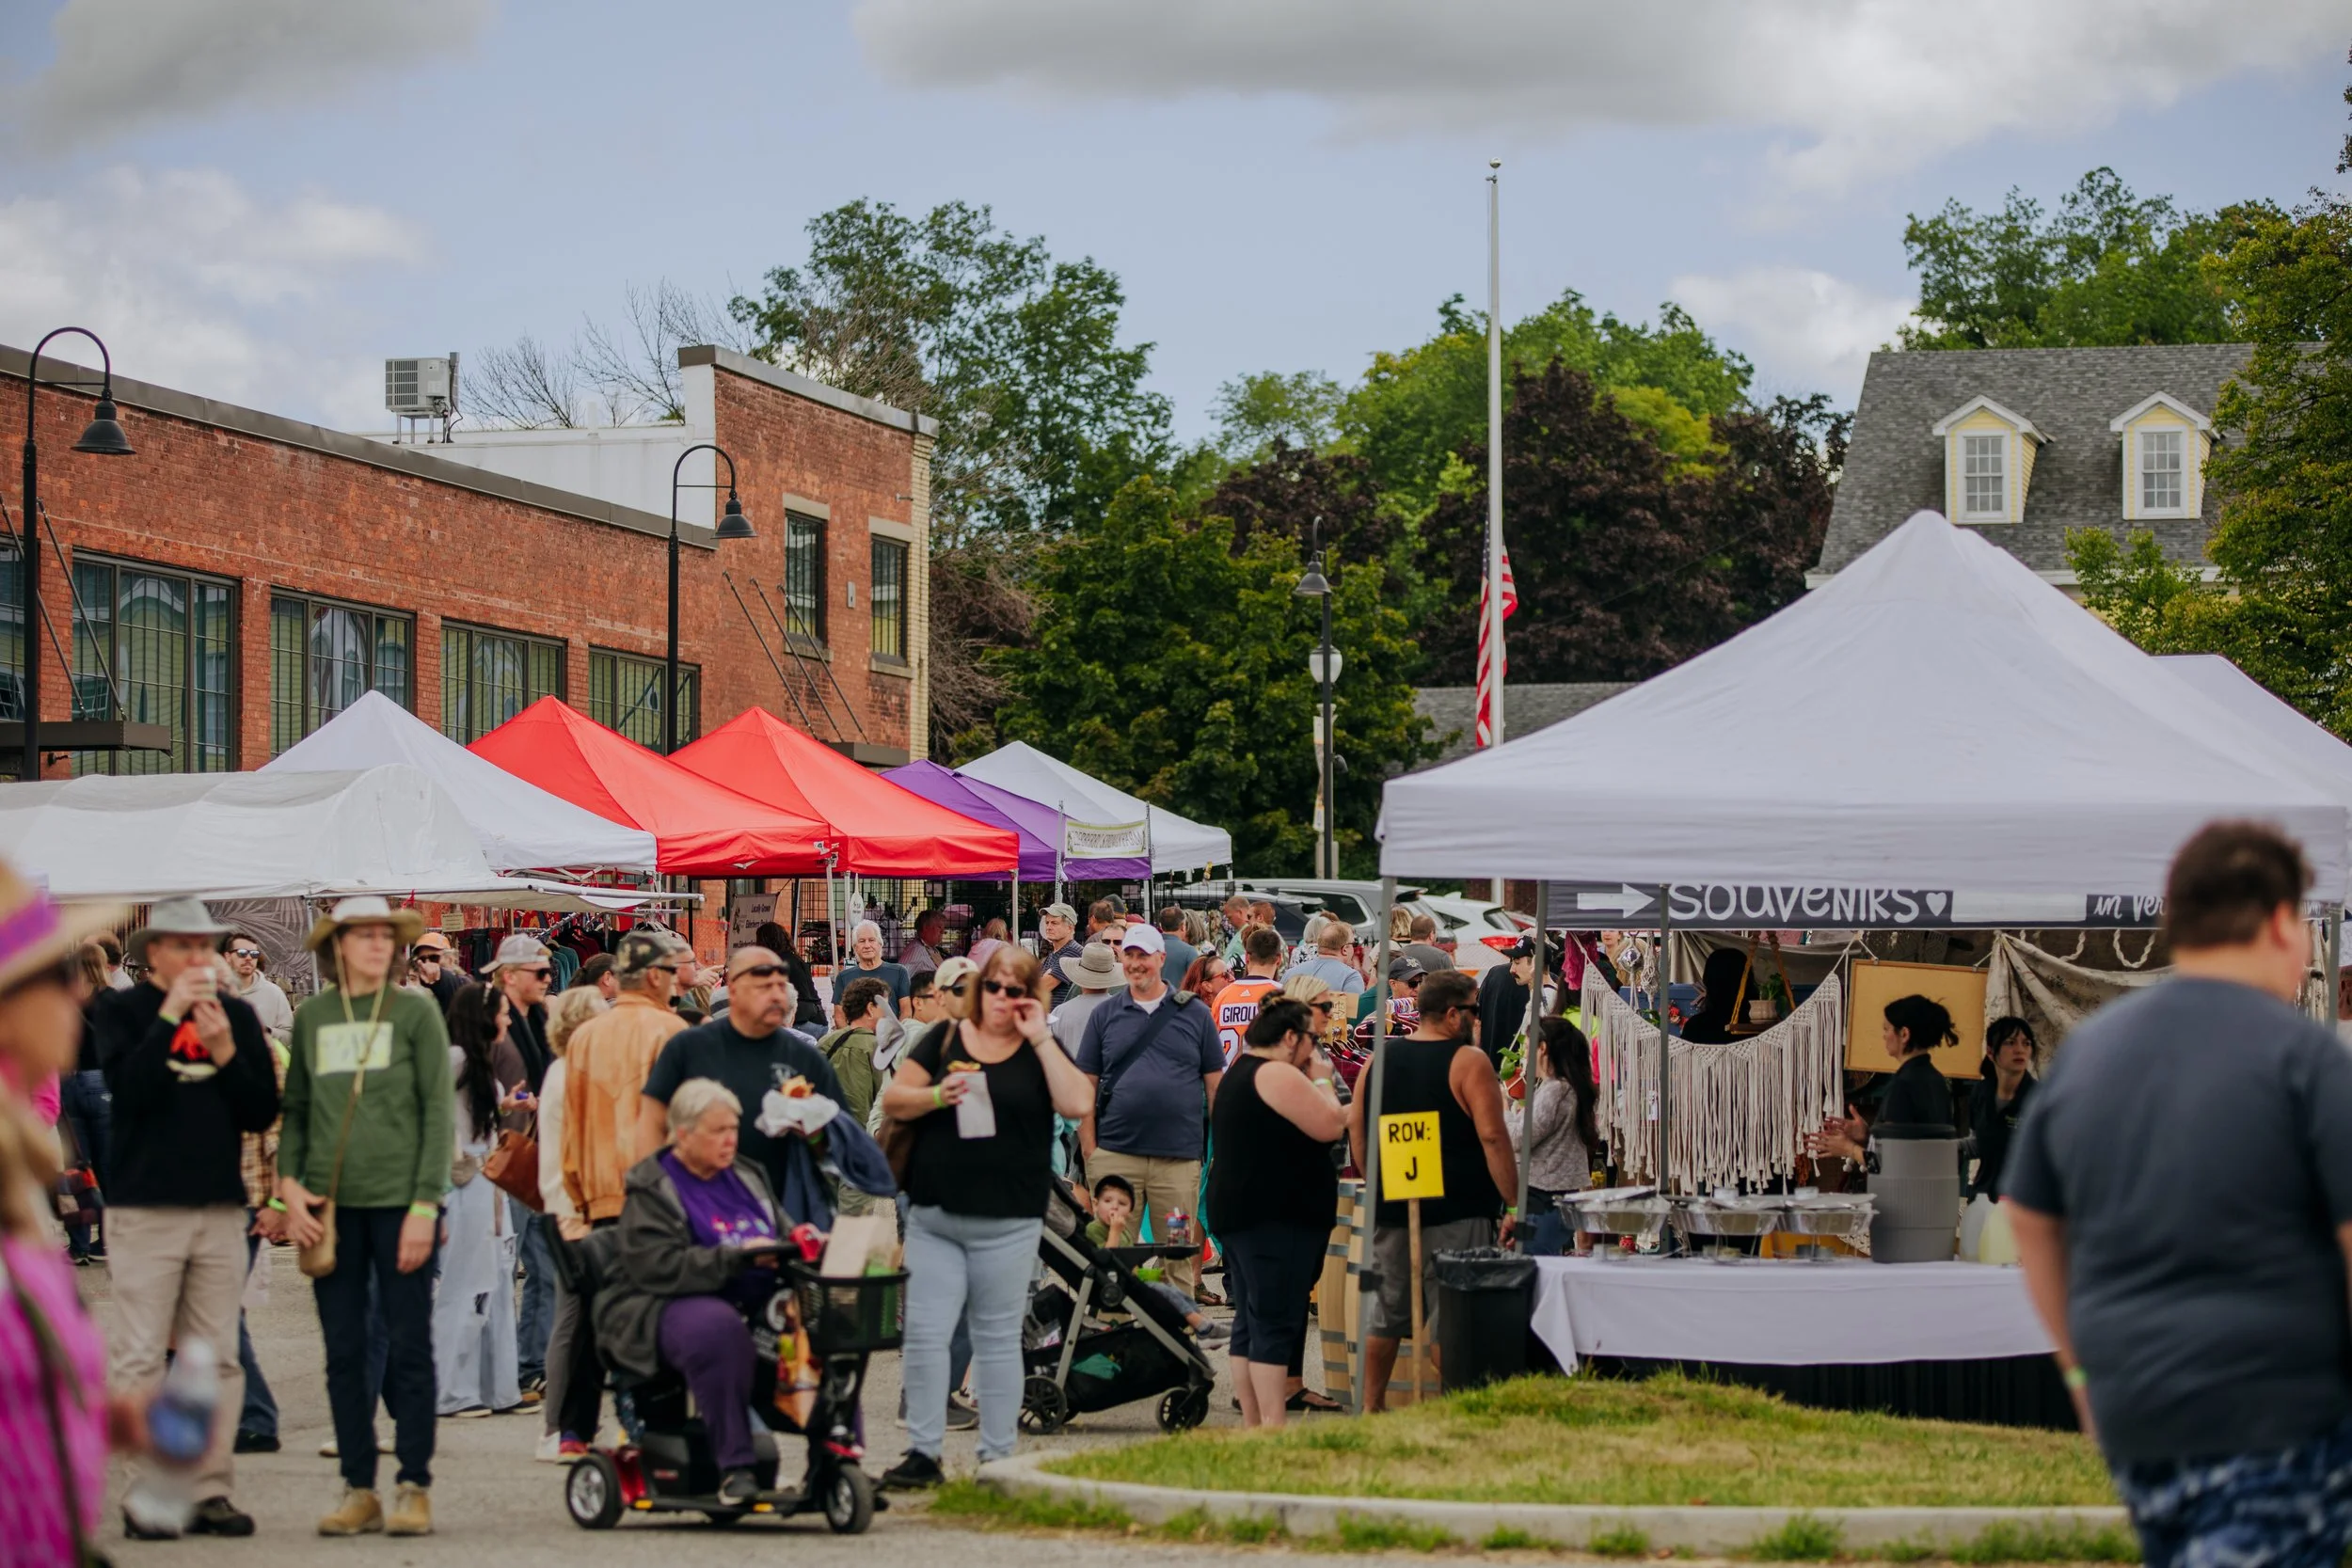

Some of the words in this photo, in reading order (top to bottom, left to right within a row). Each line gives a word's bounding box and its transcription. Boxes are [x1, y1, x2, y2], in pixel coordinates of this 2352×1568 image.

[1222, 1006, 1258, 1023] GIROU
[1388, 1120, 1431, 1144] ROW:
[1405, 1156, 1418, 1181] J
